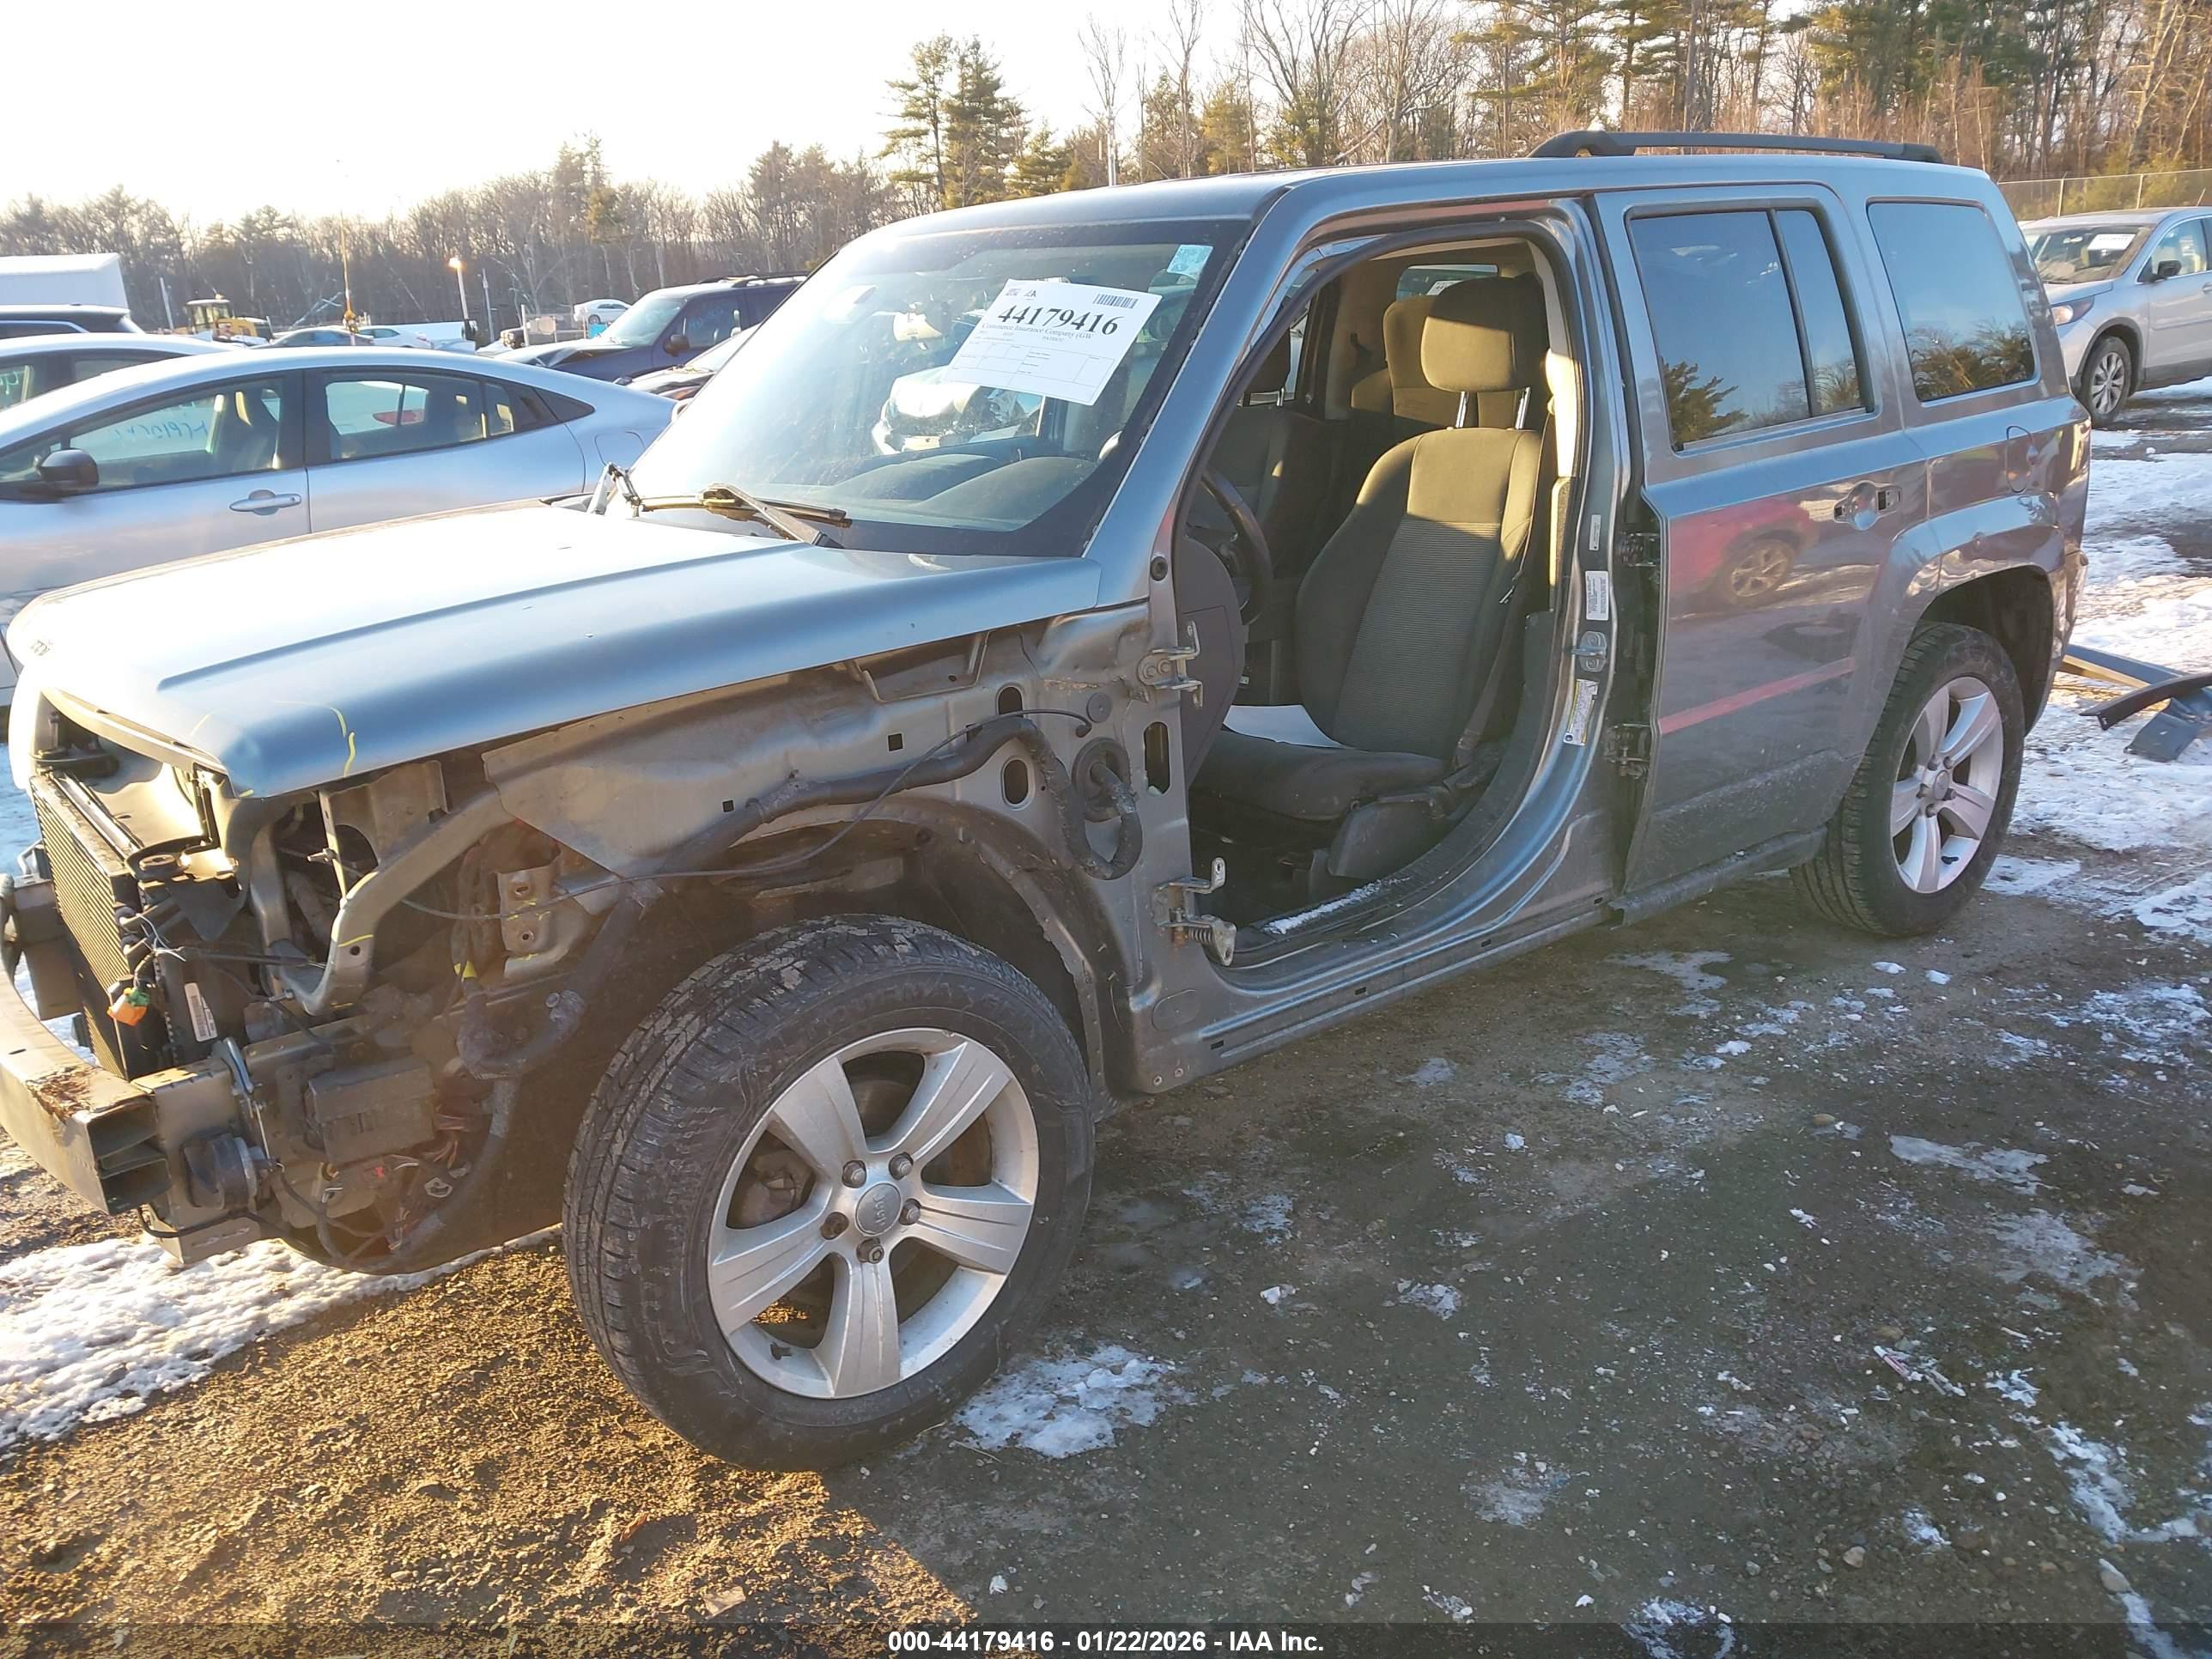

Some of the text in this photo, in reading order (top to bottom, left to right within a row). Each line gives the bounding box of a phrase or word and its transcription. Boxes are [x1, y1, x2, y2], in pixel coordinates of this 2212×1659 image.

[997, 304, 1125, 336] 44179416
[1013, 325, 1045, 334] Insurance
[1044, 327, 1075, 338] Company
